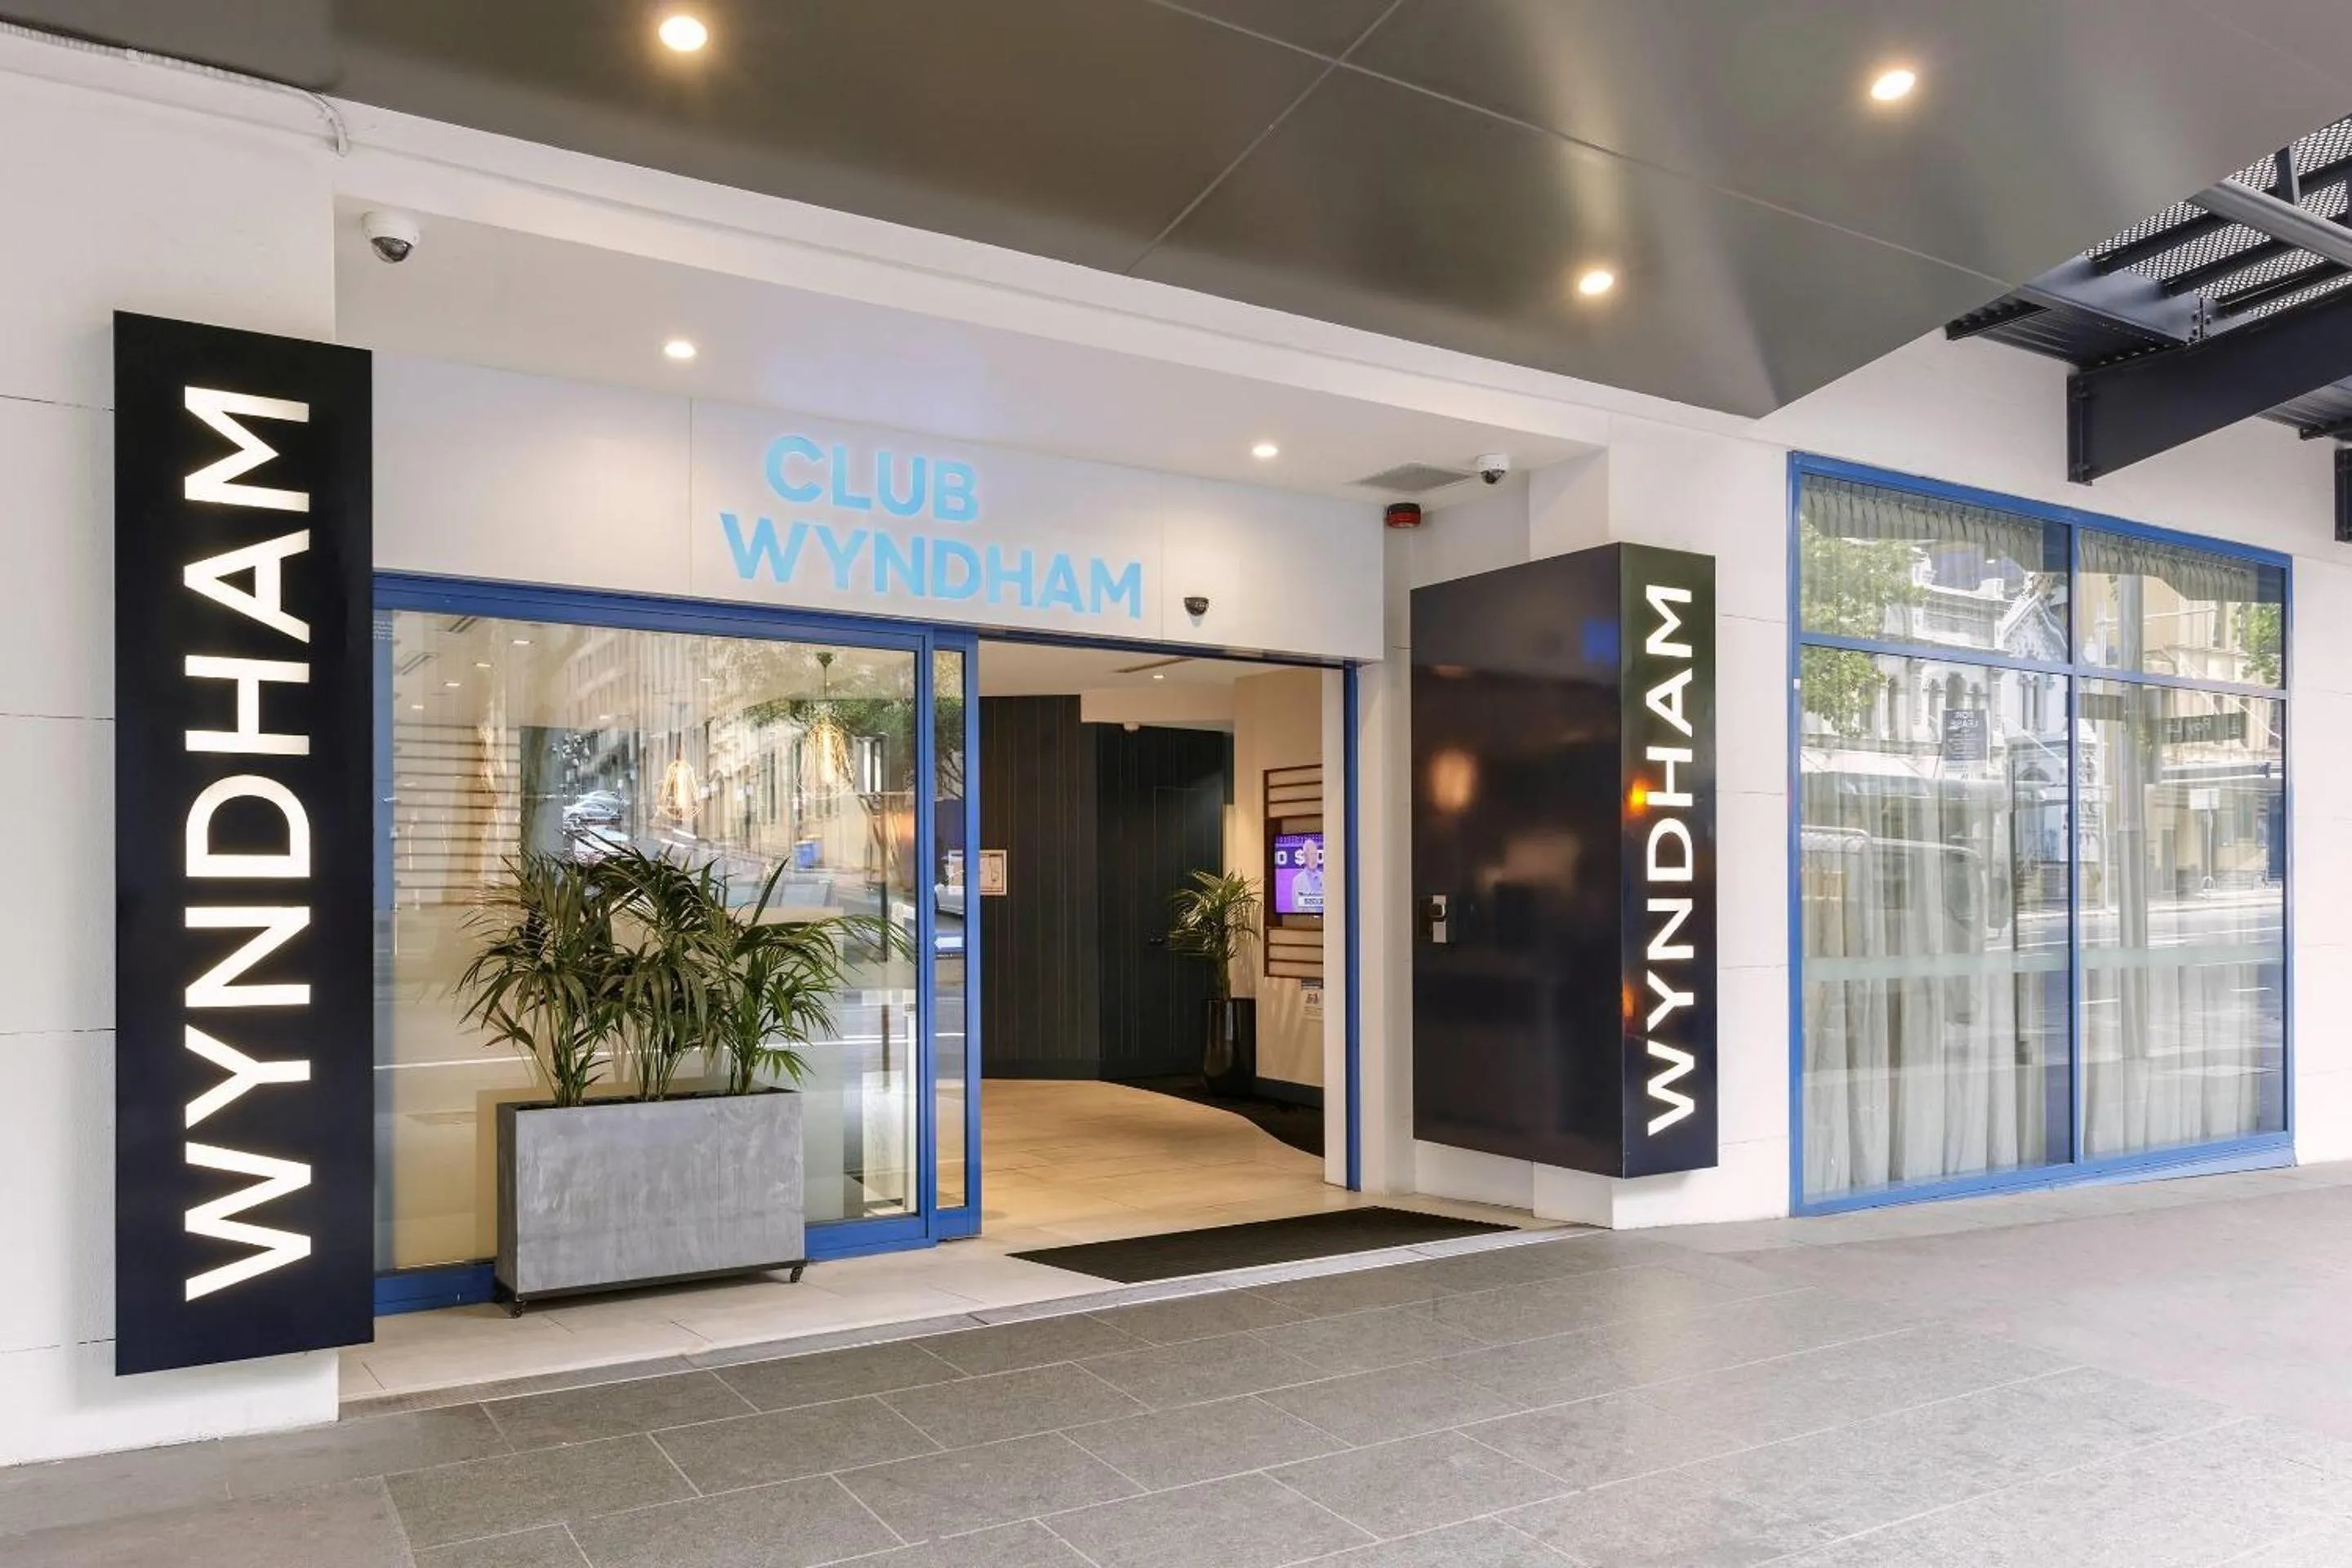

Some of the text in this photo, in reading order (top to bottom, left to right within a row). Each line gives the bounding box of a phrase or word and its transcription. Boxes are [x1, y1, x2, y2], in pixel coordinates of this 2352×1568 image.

[720, 513, 1142, 617] WYNDHAM
[766, 435, 978, 523] CLUB
[184, 385, 312, 1302] WYNDHAM
[1646, 584, 1695, 1136] WYNDHAM
